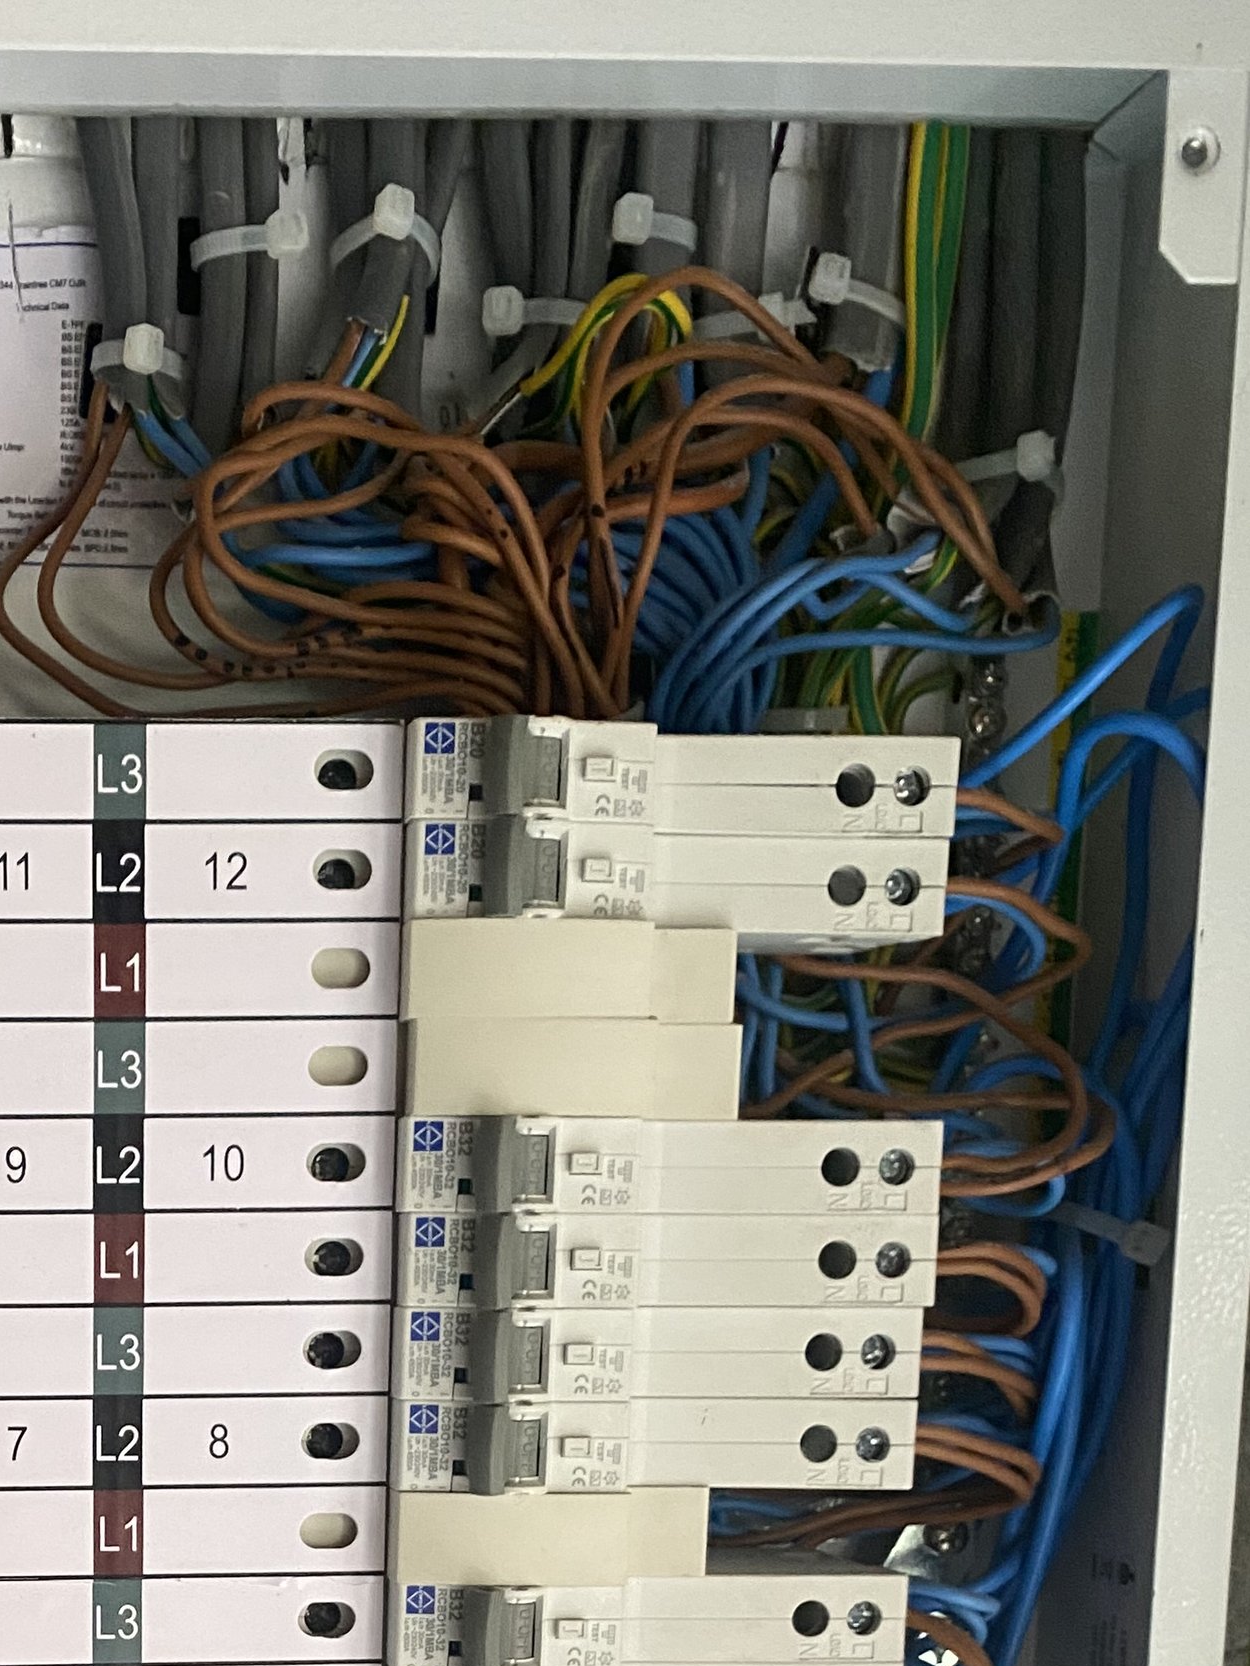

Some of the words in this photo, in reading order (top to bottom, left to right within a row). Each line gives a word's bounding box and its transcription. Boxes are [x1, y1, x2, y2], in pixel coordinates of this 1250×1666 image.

[97, 753, 143, 794] L3
[96, 852, 141, 893] L2
[205, 851, 248, 891] 12
[100, 952, 140, 993] L1
[97, 1049, 142, 1089] L3
[5, 1146, 27, 1184] 9
[96, 1145, 141, 1184] L2
[203, 1144, 245, 1182] 10
[99, 1241, 139, 1279] L1
[96, 1333, 141, 1371] L3
[7, 1426, 28, 1462] 7
[96, 1424, 139, 1462] L2
[209, 1423, 229, 1459] 8
[99, 1515, 138, 1552] L1
[95, 1604, 139, 1641] L3
[449, 1589, 463, 1620] B32
